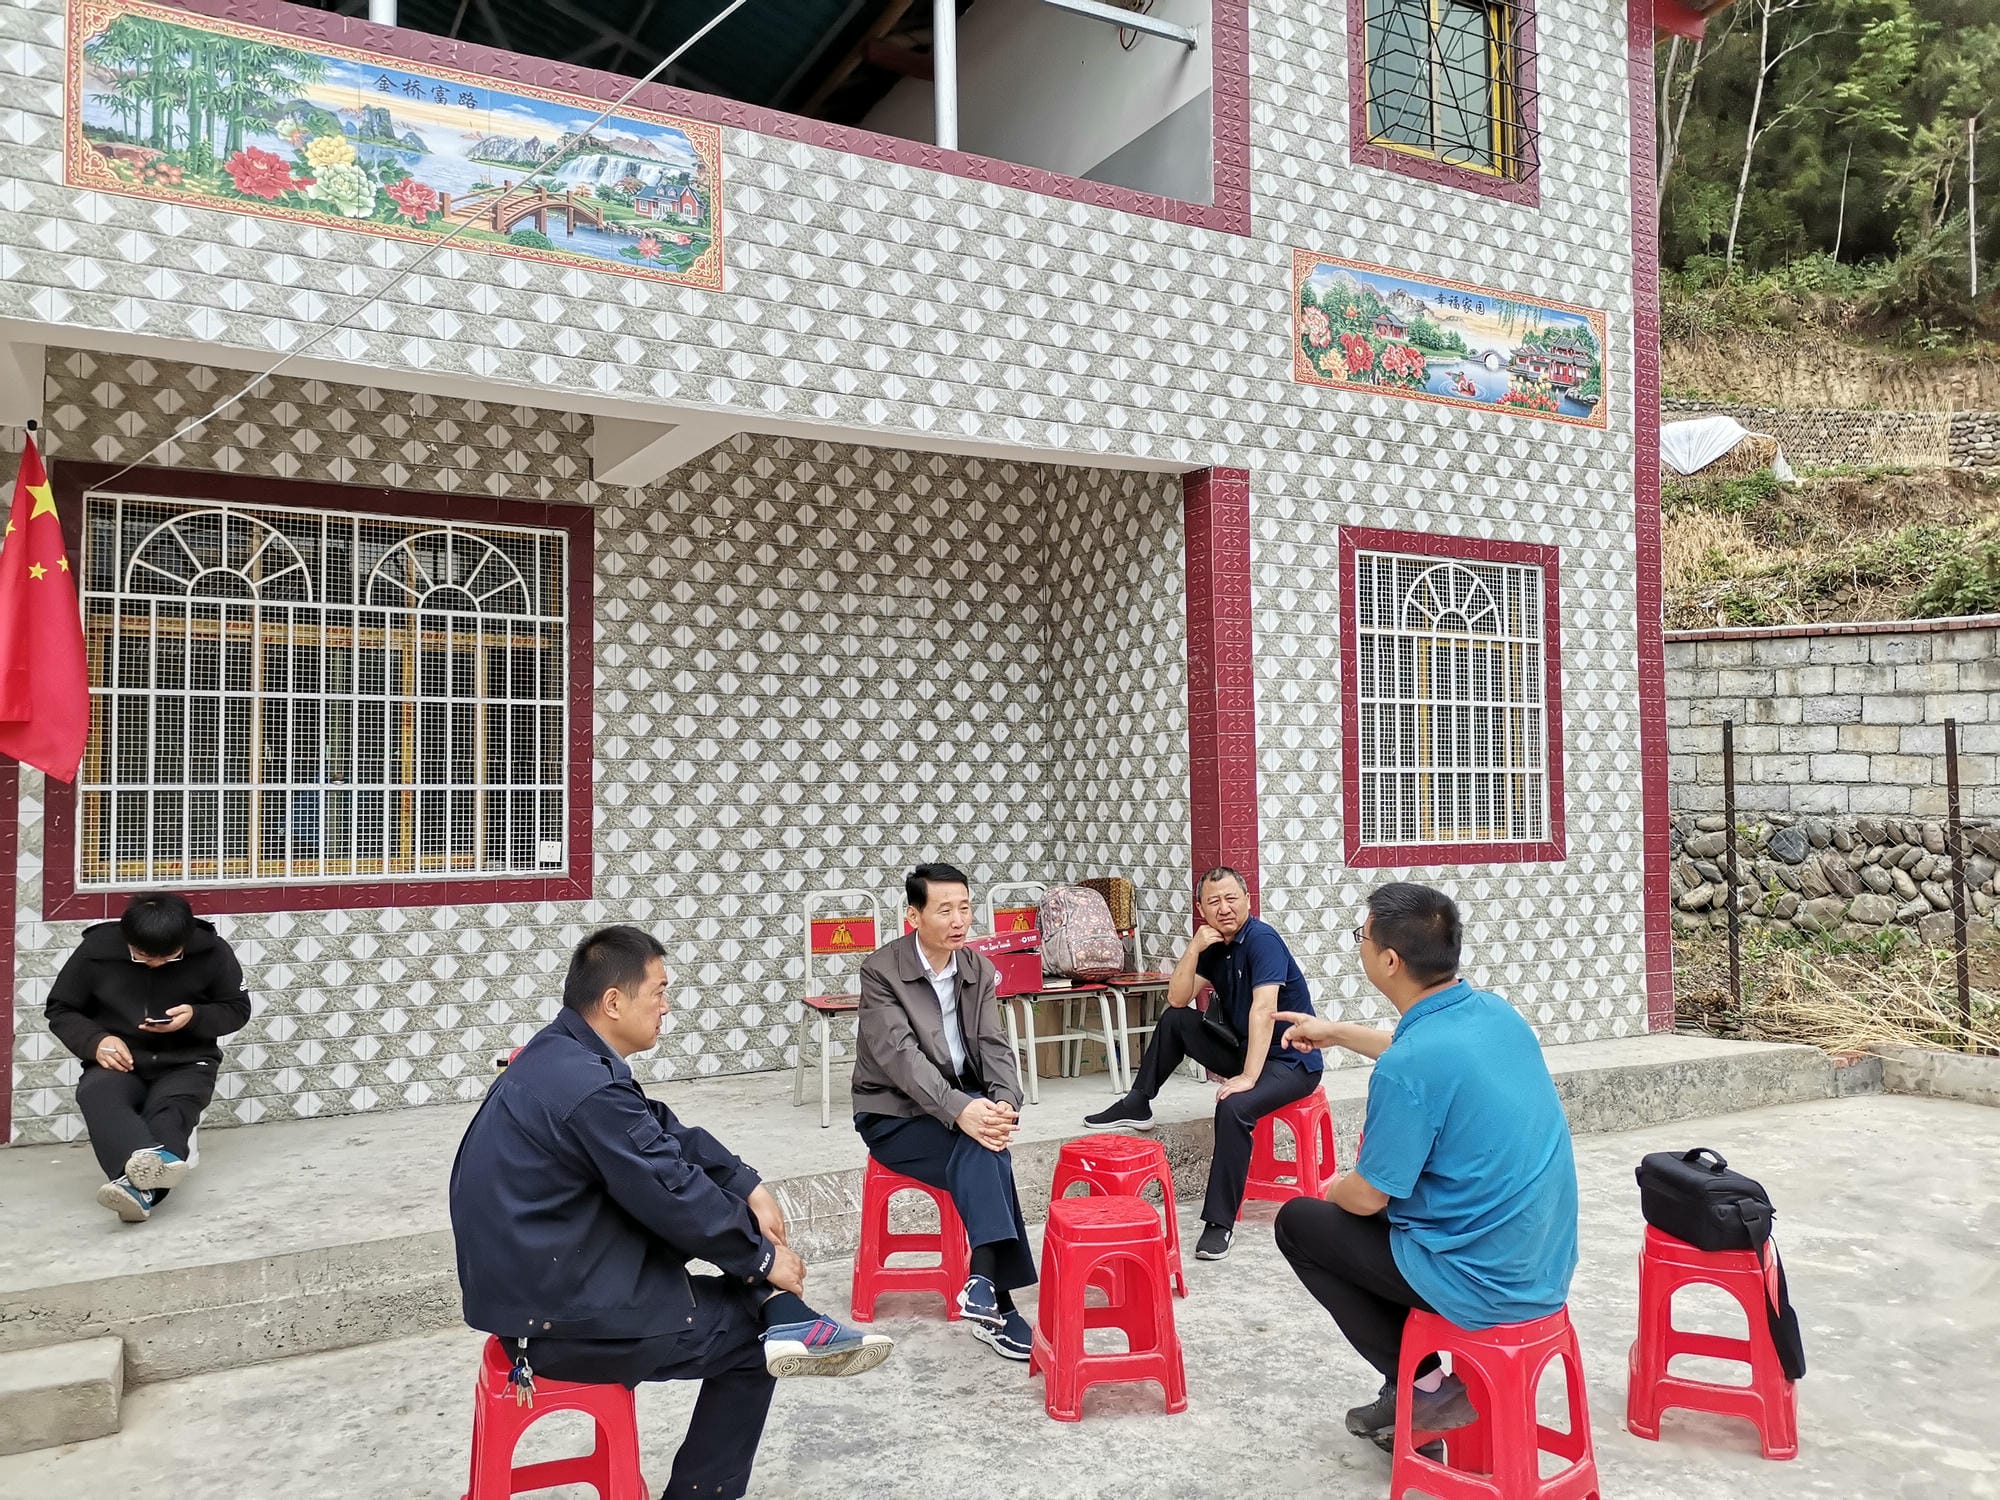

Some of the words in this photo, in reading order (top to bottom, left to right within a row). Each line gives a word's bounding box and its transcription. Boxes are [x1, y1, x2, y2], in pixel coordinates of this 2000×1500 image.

[374, 74, 477, 109] 金桥富路
[1435, 292, 1485, 315] 幸福家园
[759, 1252, 771, 1272] POLICE
